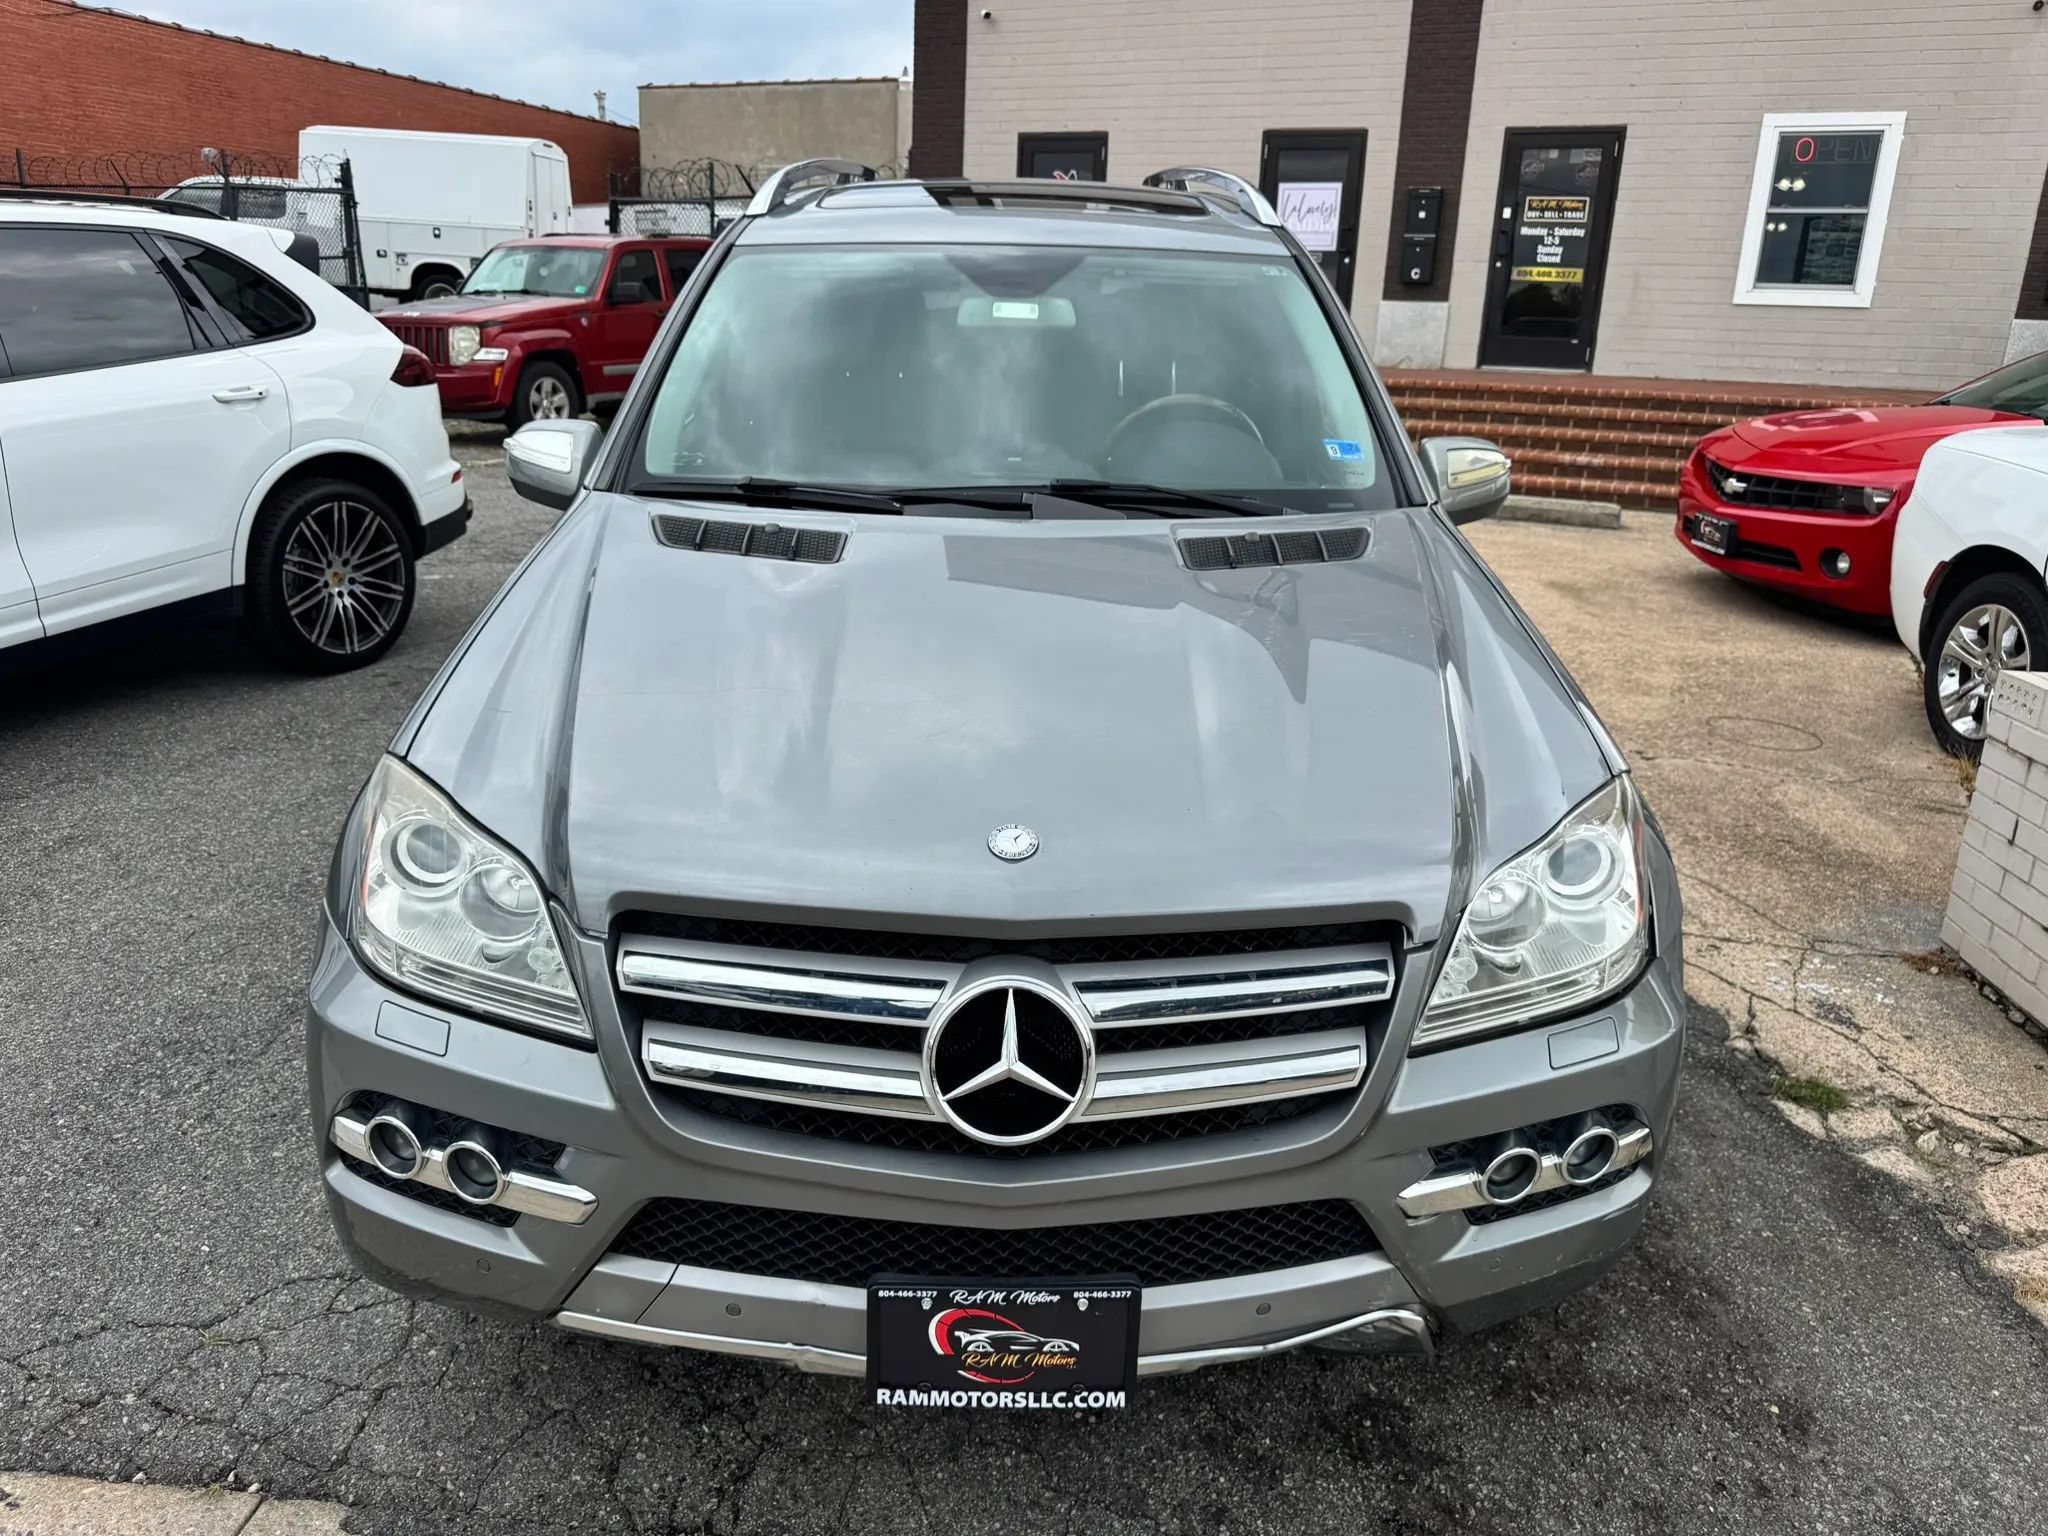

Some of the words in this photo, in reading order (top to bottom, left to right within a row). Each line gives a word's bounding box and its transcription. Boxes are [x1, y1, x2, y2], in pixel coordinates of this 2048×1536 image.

[1796, 137, 1873, 161] OPEN
[1526, 210, 1540, 218] BUY
[1544, 210, 1559, 219] SELL
[1563, 211, 1585, 219] TRADE
[1520, 226, 1548, 236] Monday
[1553, 227, 1586, 238] Saturday
[1537, 245, 1564, 255] Sunday
[1536, 254, 1561, 263] Closed
[878, 1290, 938, 1298] 804-466-3377
[949, 1290, 1006, 1305] RAM
[1010, 1290, 1061, 1305] Motors
[1073, 1291, 1132, 1299] 804-466-3377
[961, 1352, 1022, 1368] RAM
[1024, 1353, 1077, 1367] Motors
[877, 1388, 1126, 1409] RAMMOTORSLLC.COM
